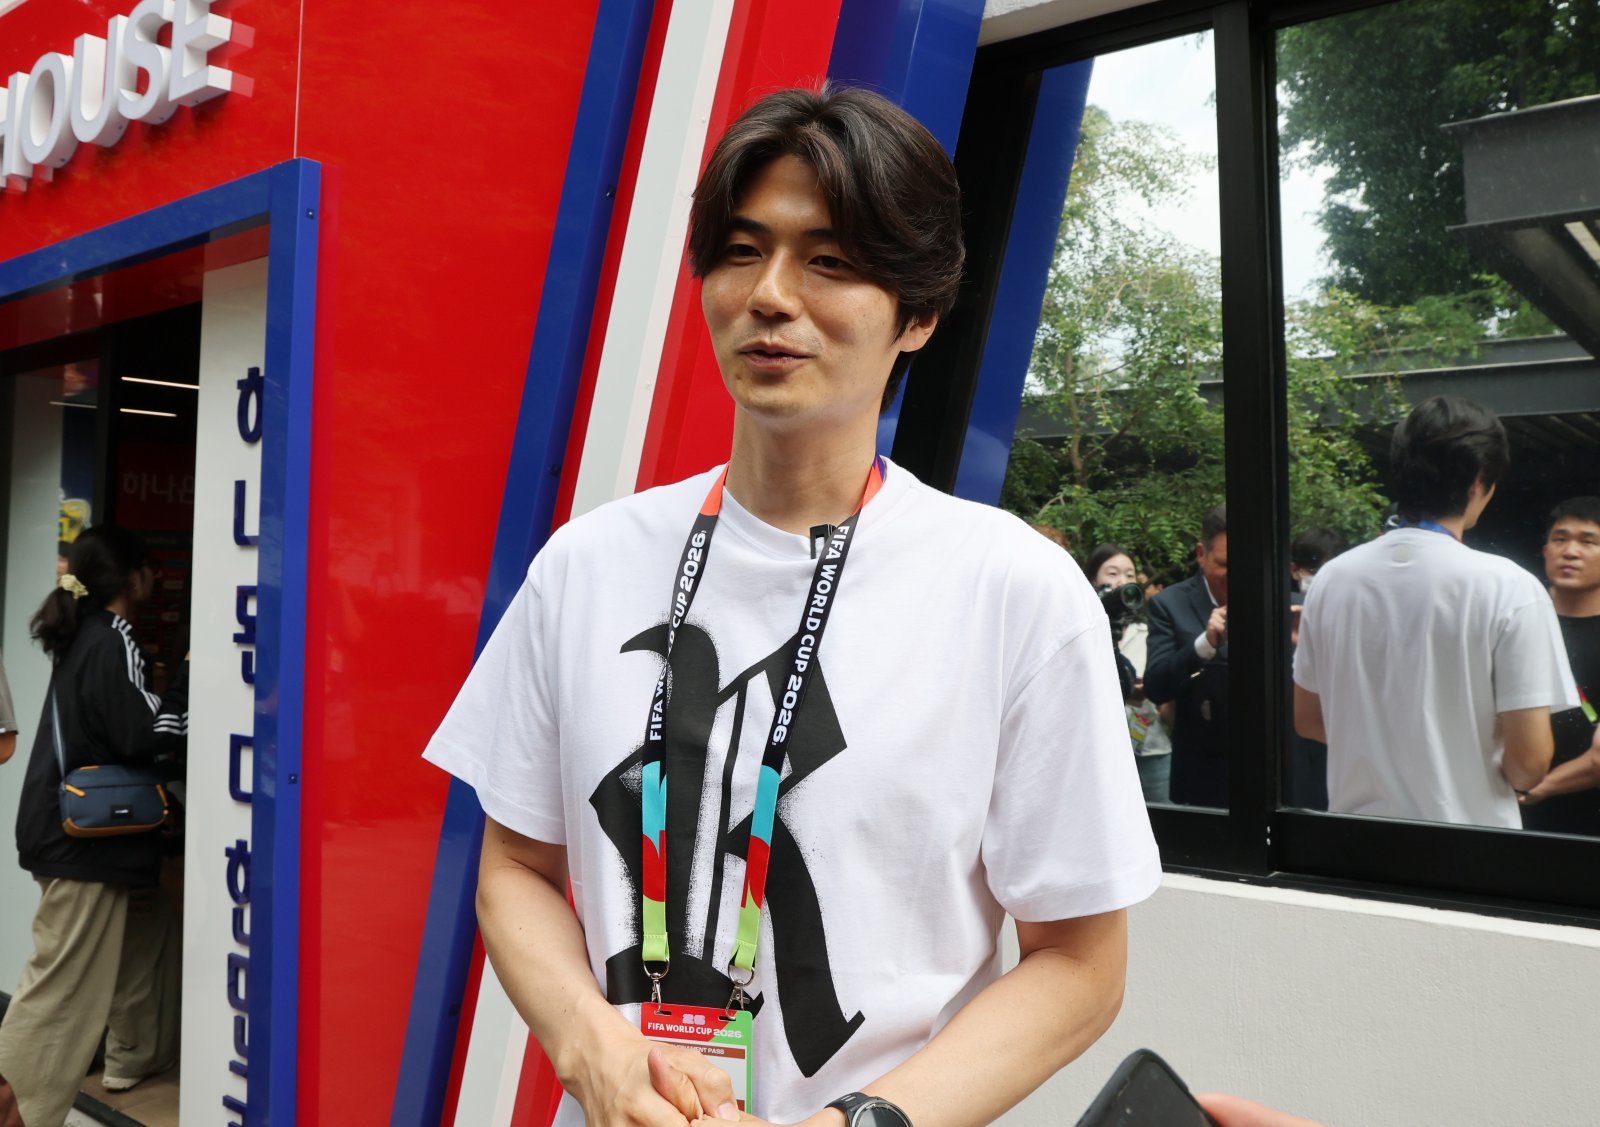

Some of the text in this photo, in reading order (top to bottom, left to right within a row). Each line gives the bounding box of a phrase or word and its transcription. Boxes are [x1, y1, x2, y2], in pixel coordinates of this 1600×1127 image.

[649, 532, 706, 741] FIFA WOD CUP 2026
[772, 525, 850, 743] FIFA WORLD CUP 2026
[647, 1022, 742, 1039] FIFA WORLD CUP 2026
[708, 1047, 725, 1055] PASS
